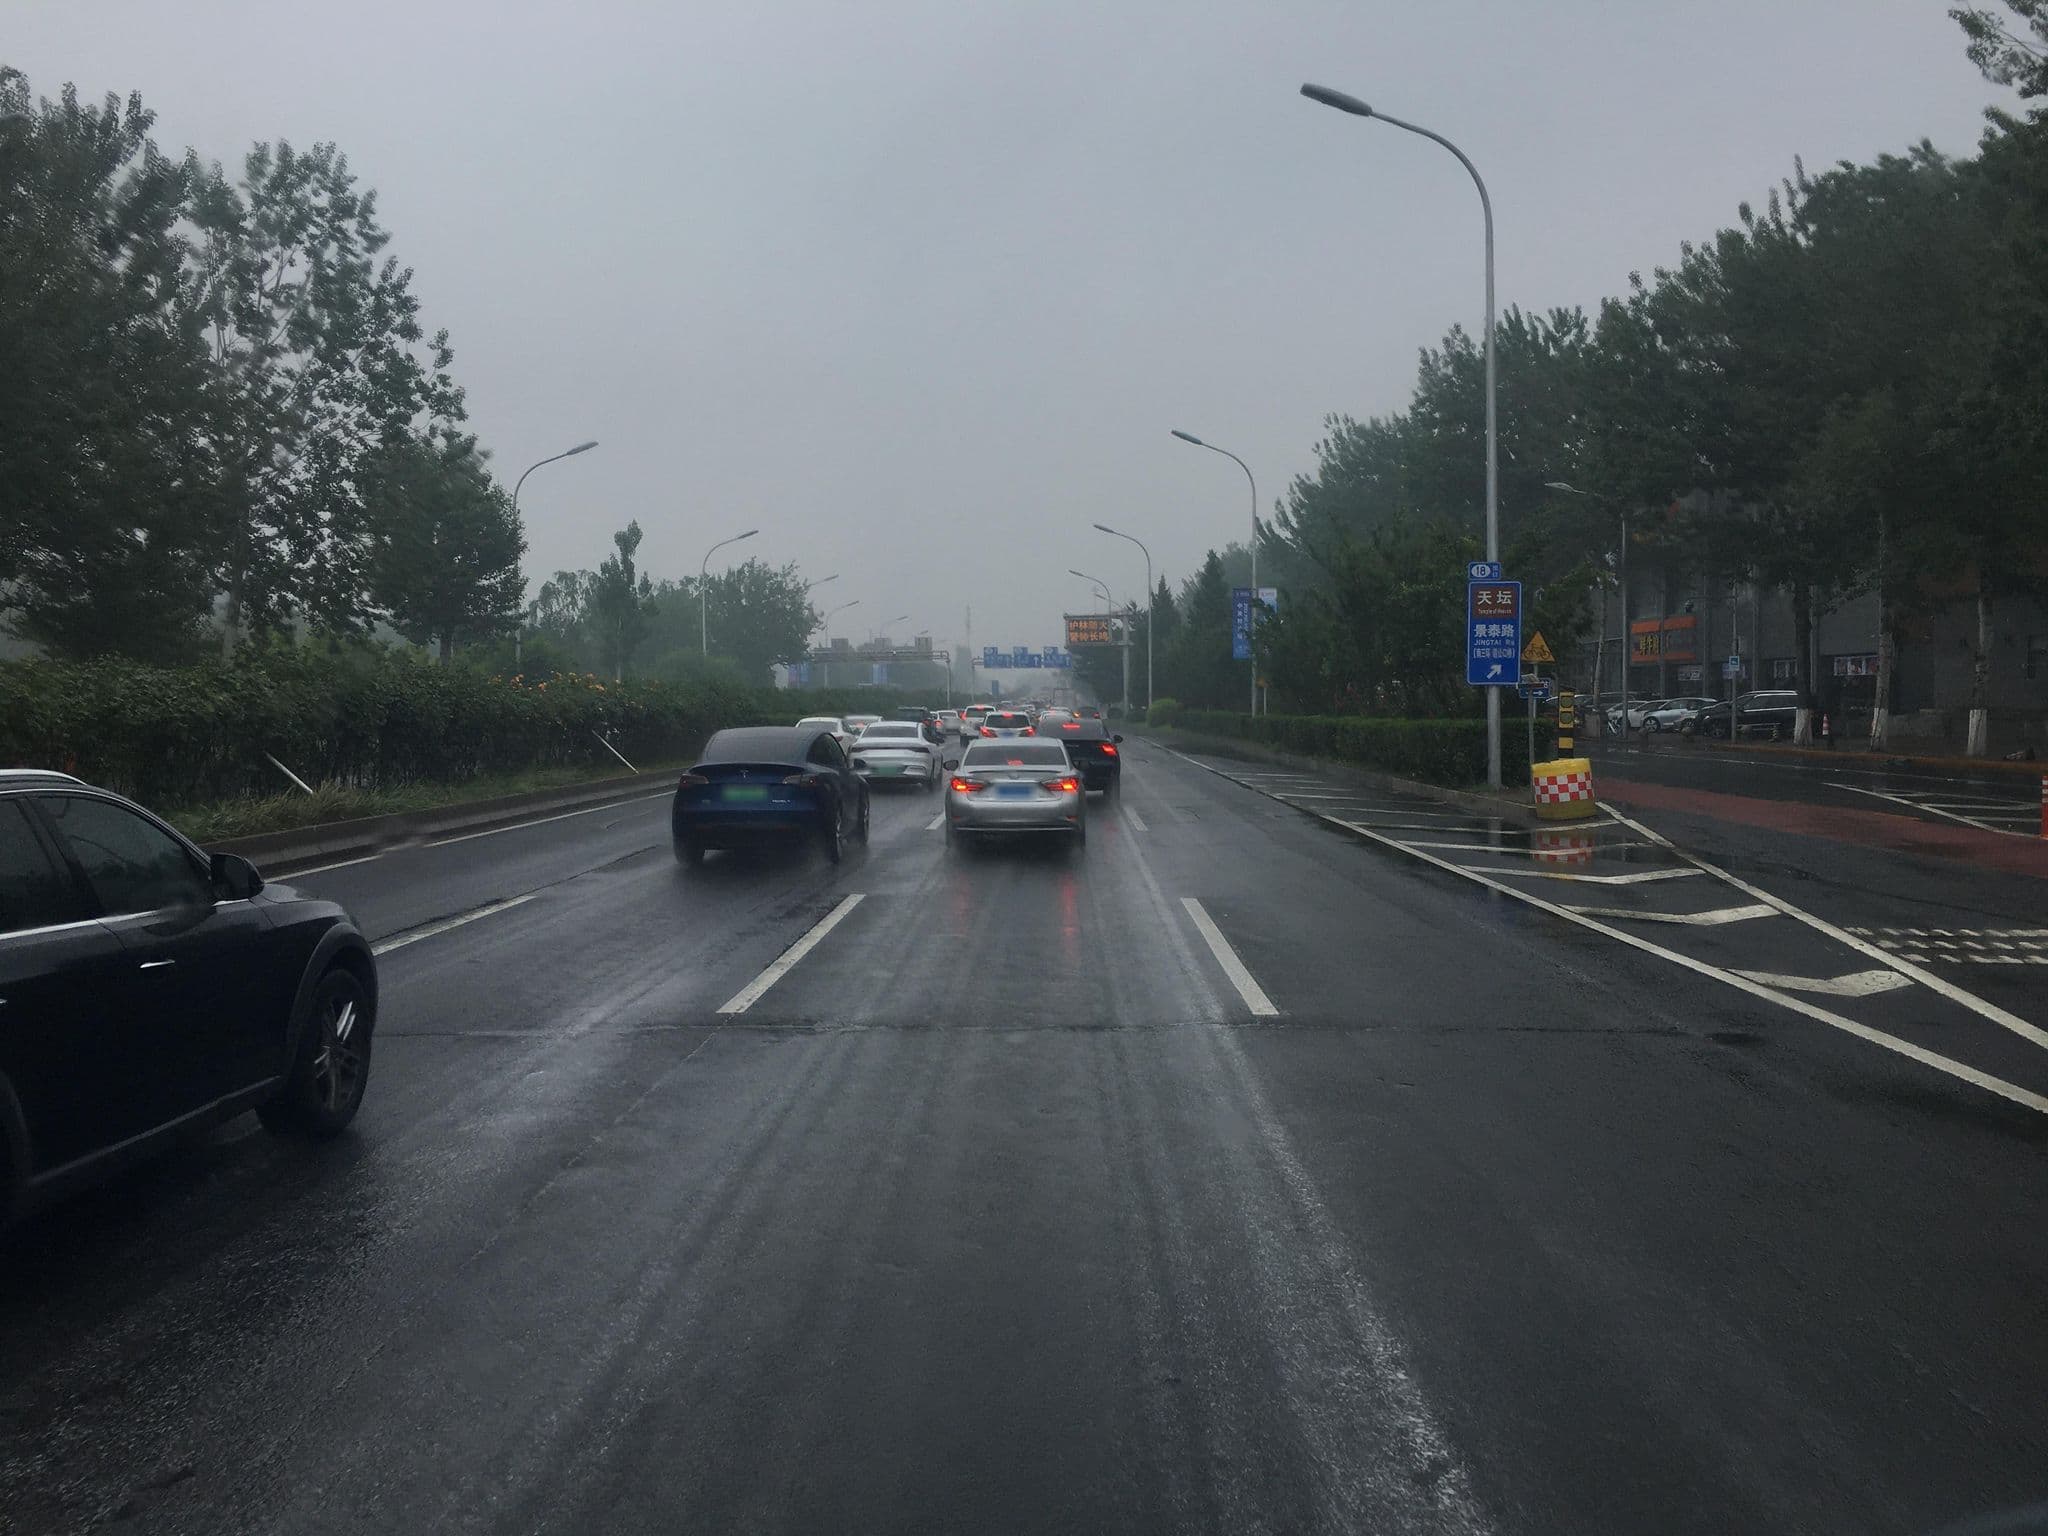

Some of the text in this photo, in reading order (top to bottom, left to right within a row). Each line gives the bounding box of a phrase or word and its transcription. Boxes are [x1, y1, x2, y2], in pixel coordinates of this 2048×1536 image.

[1476, 566, 1486, 576] 18
[1477, 591, 1512, 605] 天坛
[1473, 624, 1514, 638] 景泰路
